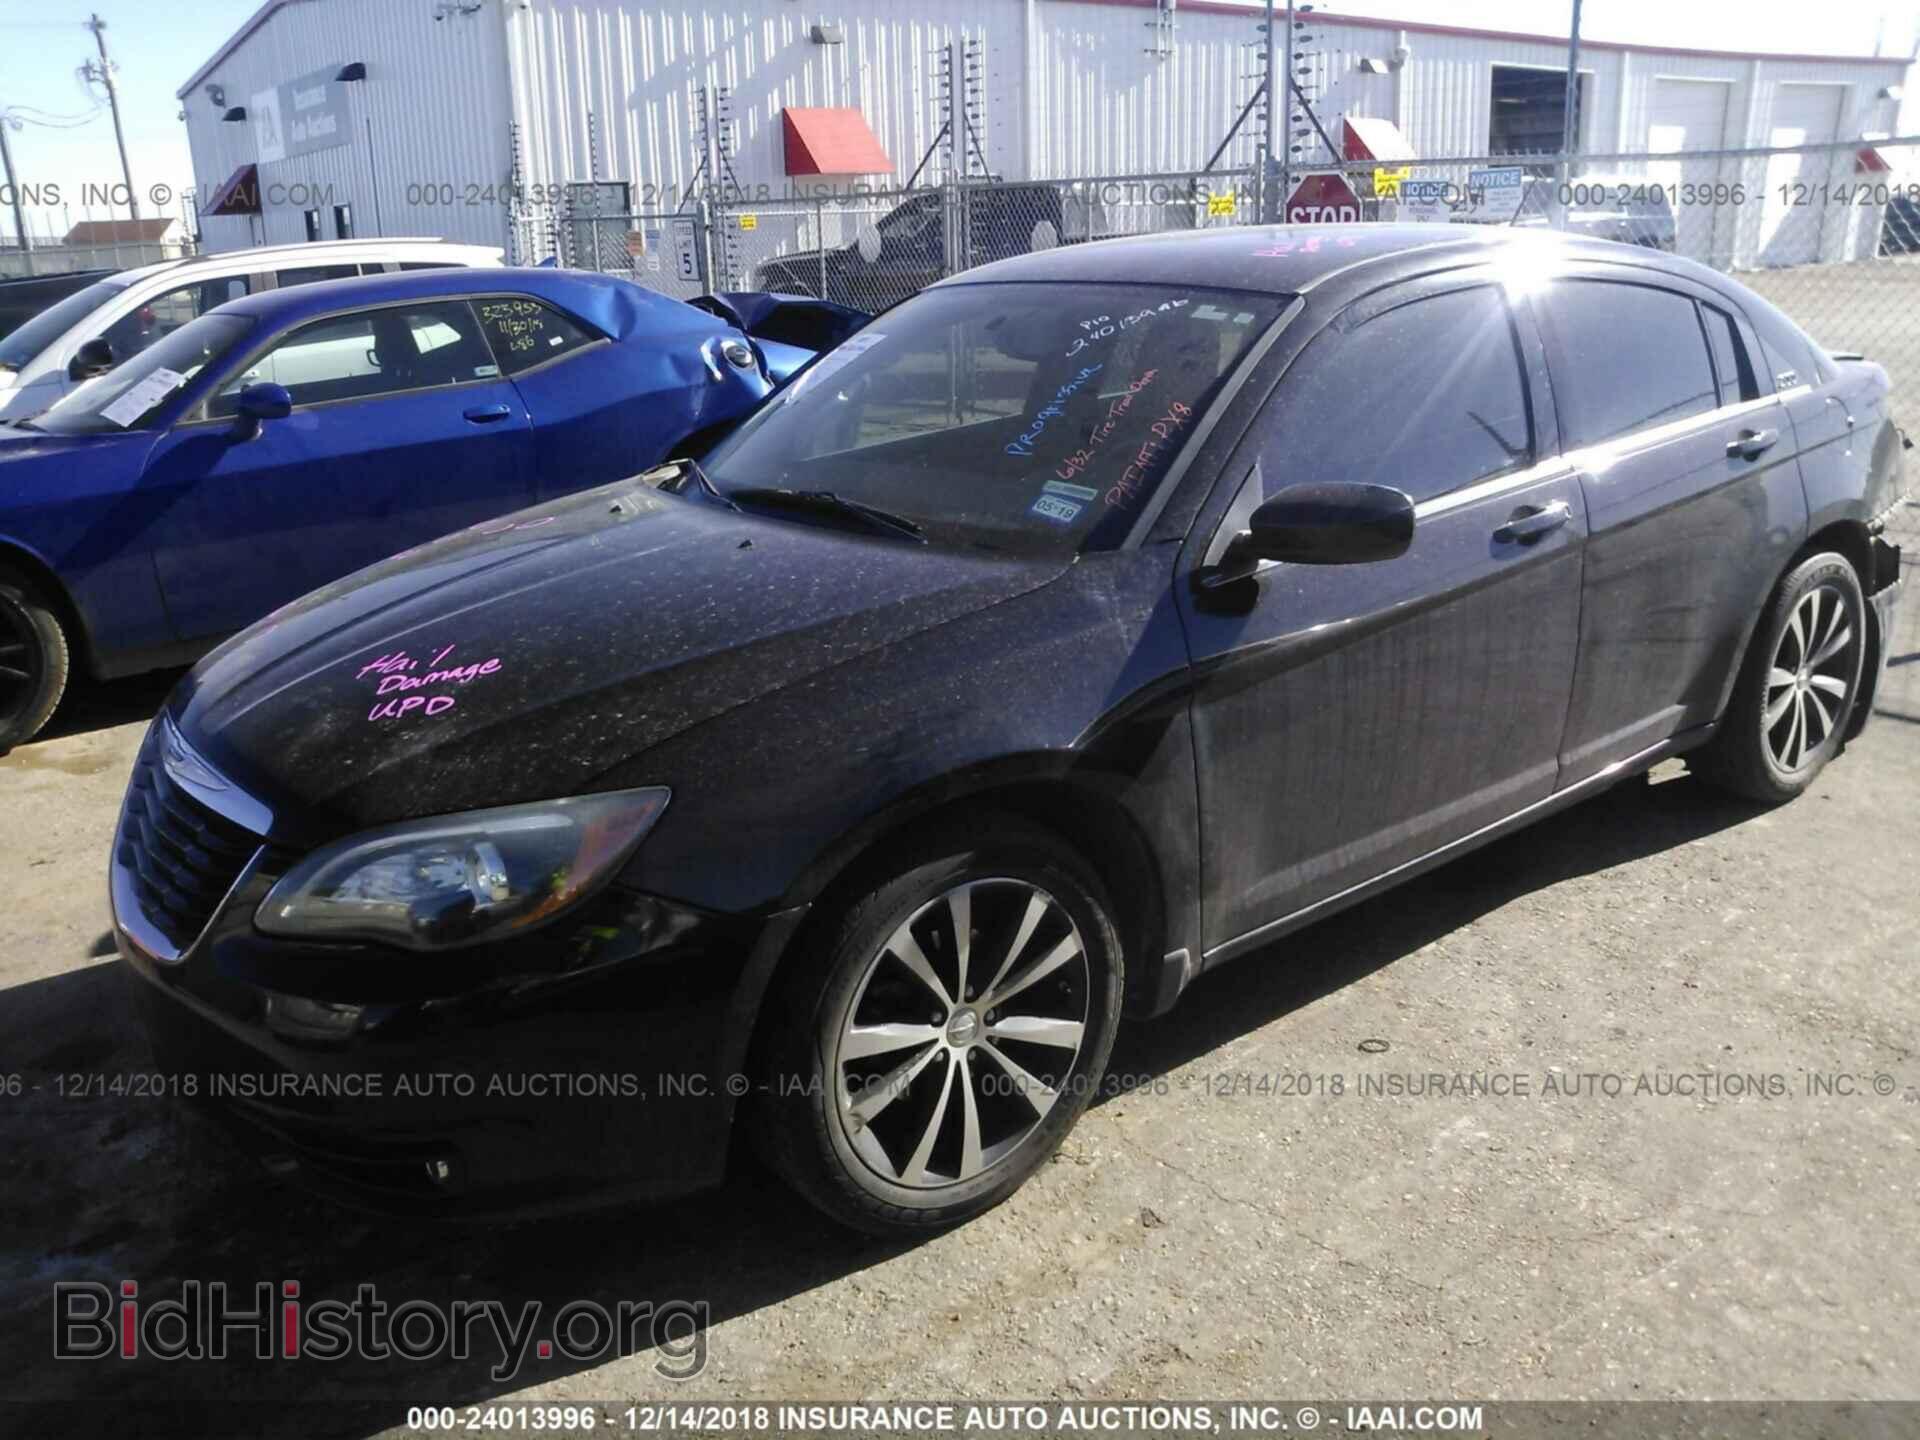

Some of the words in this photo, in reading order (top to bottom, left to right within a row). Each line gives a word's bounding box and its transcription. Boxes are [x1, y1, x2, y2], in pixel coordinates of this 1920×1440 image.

[1472, 171, 1519, 187] NOTICE
[1290, 205, 1356, 224] STOP
[683, 253, 692, 274] 5
[376, 658, 502, 695] Damage
